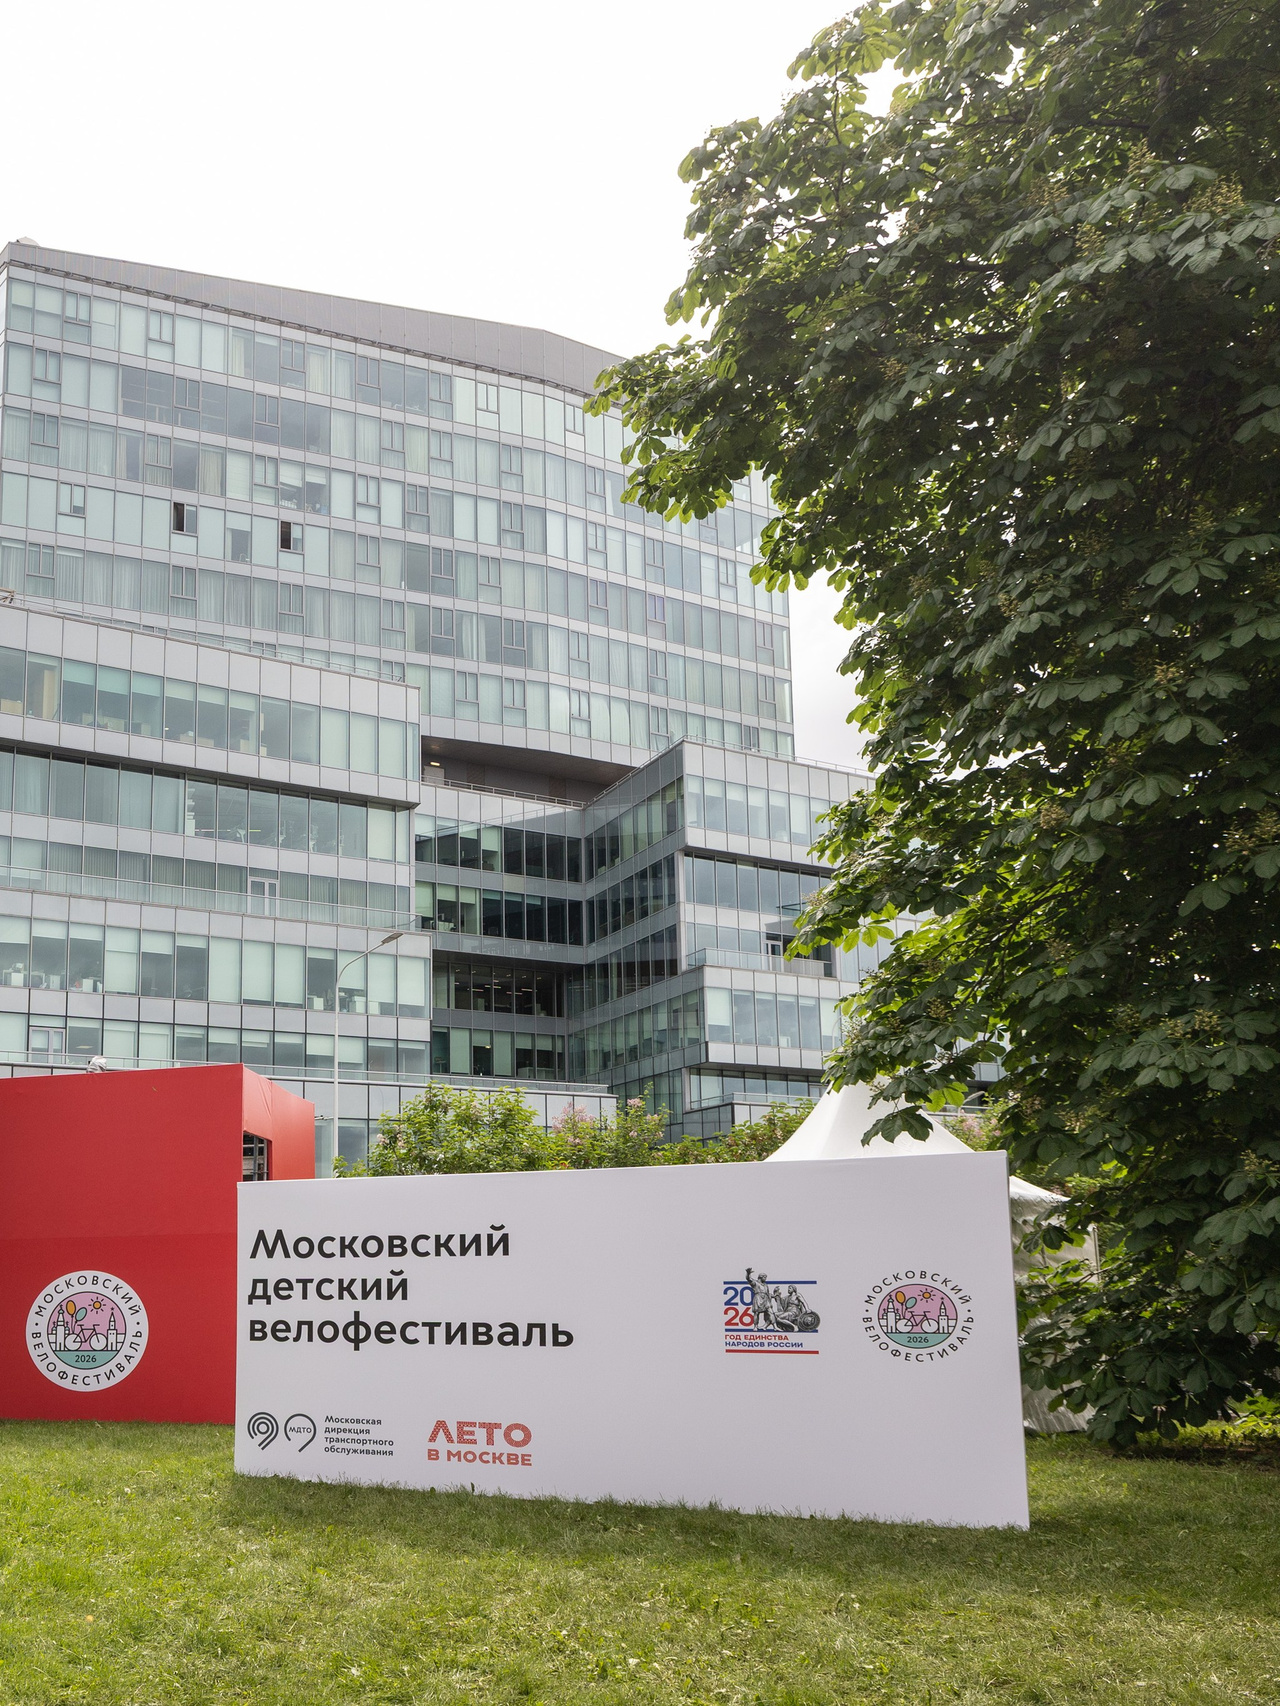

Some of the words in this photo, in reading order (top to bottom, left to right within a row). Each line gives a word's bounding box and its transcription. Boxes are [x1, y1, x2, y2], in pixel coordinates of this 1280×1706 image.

[249, 1223, 510, 1259] Московский
[34, 1275, 142, 1318] МОСКОВСКИЙ
[248, 1269, 409, 1305] детский
[723, 1286, 755, 1306] 20
[864, 1270, 972, 1306] МОСКОВСКИЙ
[723, 1306, 755, 1327] 26
[249, 1310, 575, 1351] велофестиваль
[744, 1334, 790, 1342] ЕДИНСТВА
[862, 1316, 975, 1363] ВЕЛОФЕСТИВАЛЬ
[906, 1336, 930, 1344] 2026
[724, 1341, 766, 1349] НАРОДОВ
[767, 1341, 804, 1349] РОССИИ
[31, 1330, 143, 1386] ВЕЛОФЕСТИВАЛЬ
[74, 1354, 97, 1363] 2026
[324, 1415, 383, 1426] Московская
[288, 1426, 313, 1435] МДТО
[323, 1426, 372, 1436] дирекция
[427, 1419, 533, 1448] ЛЕТО
[324, 1436, 395, 1447] транспортного
[323, 1446, 395, 1457] обслуживания
[427, 1448, 440, 1461] В
[446, 1449, 533, 1467] МОСКВЕ
